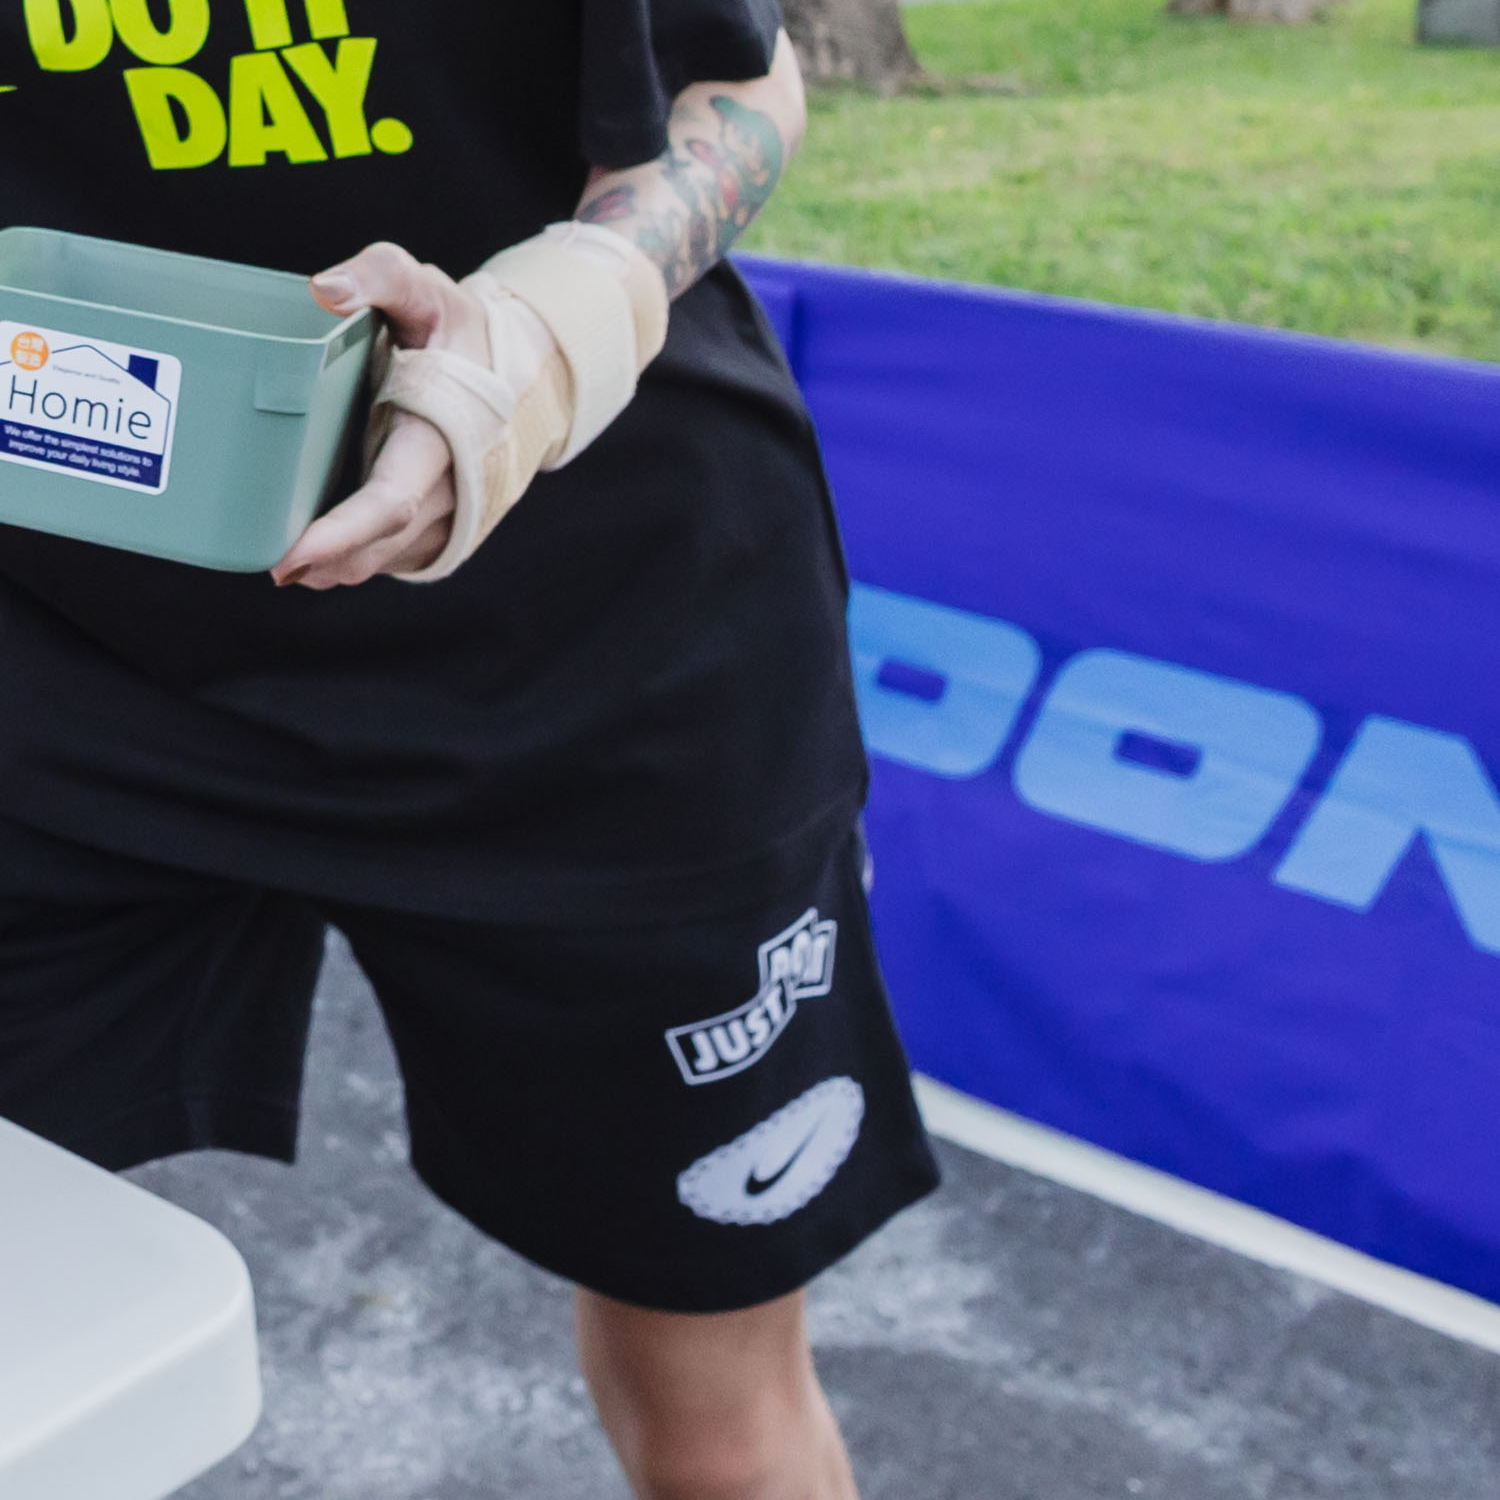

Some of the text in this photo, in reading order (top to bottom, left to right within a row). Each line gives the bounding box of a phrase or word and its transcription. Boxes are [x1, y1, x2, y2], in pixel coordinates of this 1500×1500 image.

[122, 37, 413, 170] DAY.
[8, 374, 152, 440] Homie
[44, 434, 60, 446] the
[690, 986, 785, 1073] JUST
